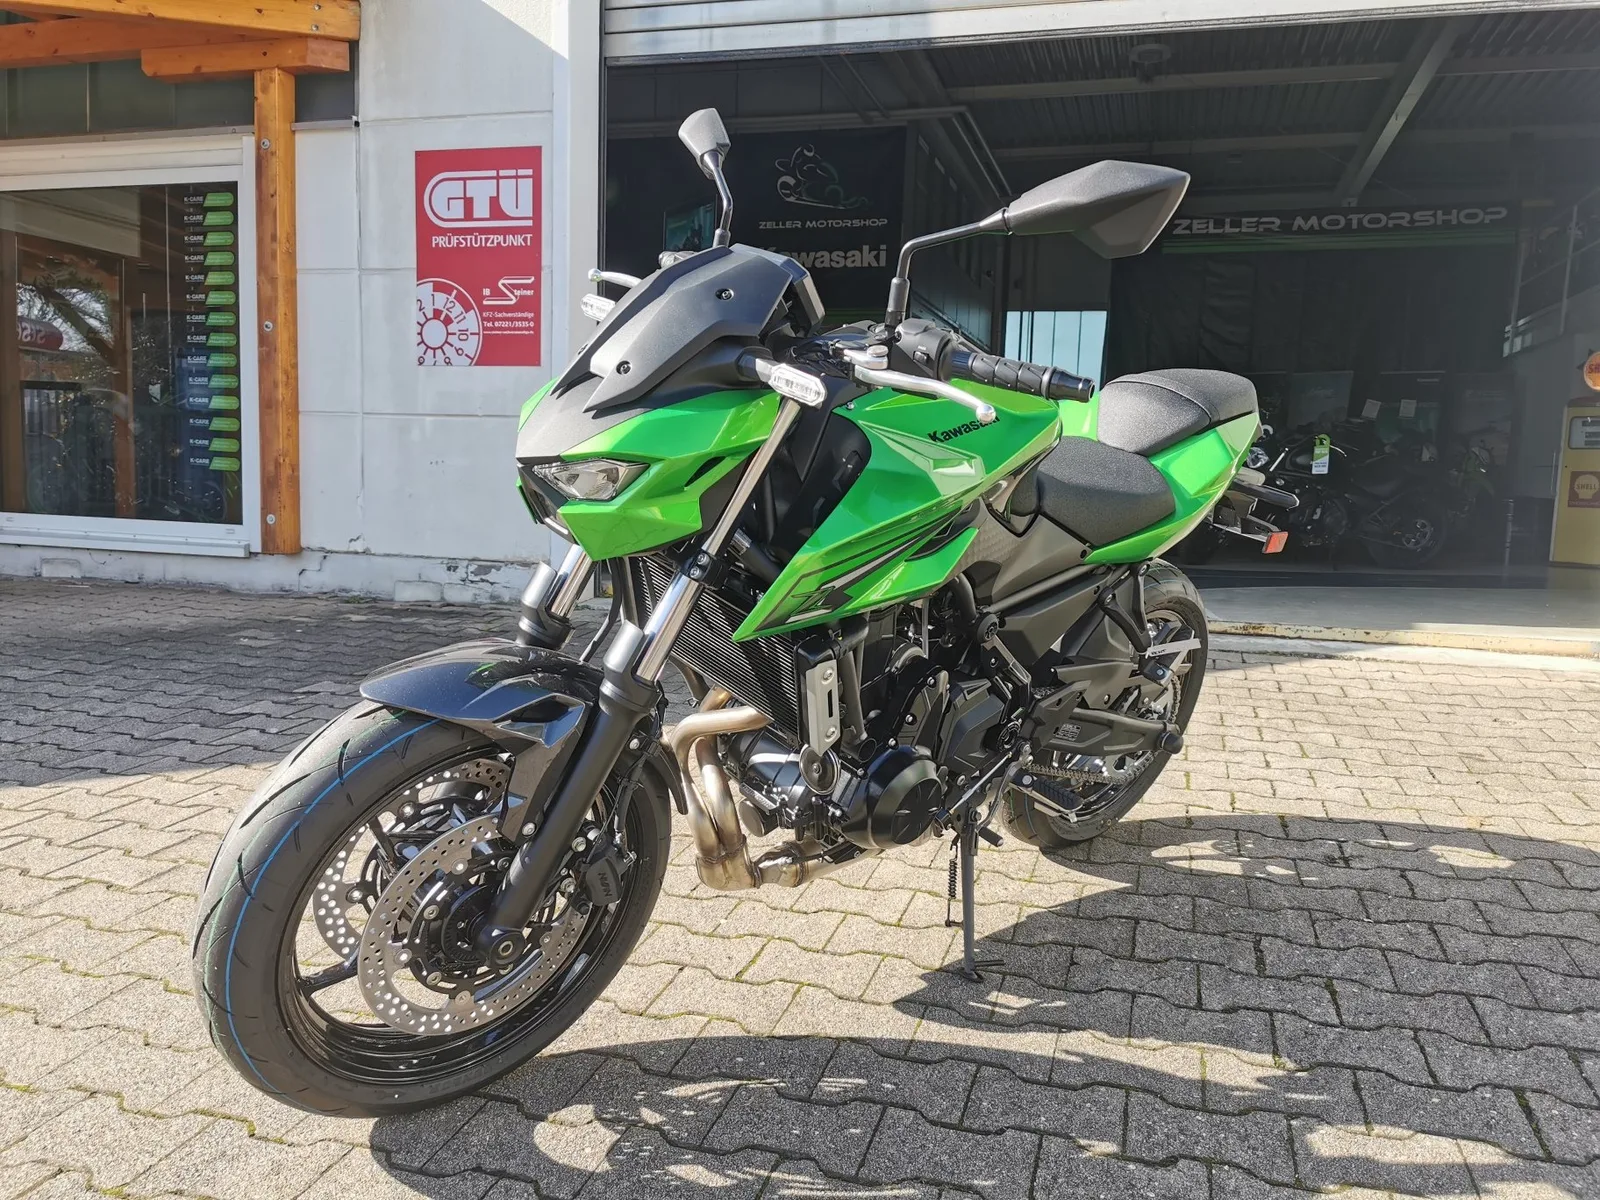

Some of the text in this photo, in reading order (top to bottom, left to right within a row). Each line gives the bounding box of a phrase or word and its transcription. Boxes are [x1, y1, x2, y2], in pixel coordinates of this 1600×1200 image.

[424, 169, 533, 228] GTÜ
[759, 218, 888, 229] ZELLER MOTORSHOP
[1172, 207, 1508, 235] ZELLER MOTORSHOP
[431, 233, 533, 248] PRÜFSTÜTZPUNKT
[761, 245, 887, 268] wasaki
[443, 297, 456, 313] 12
